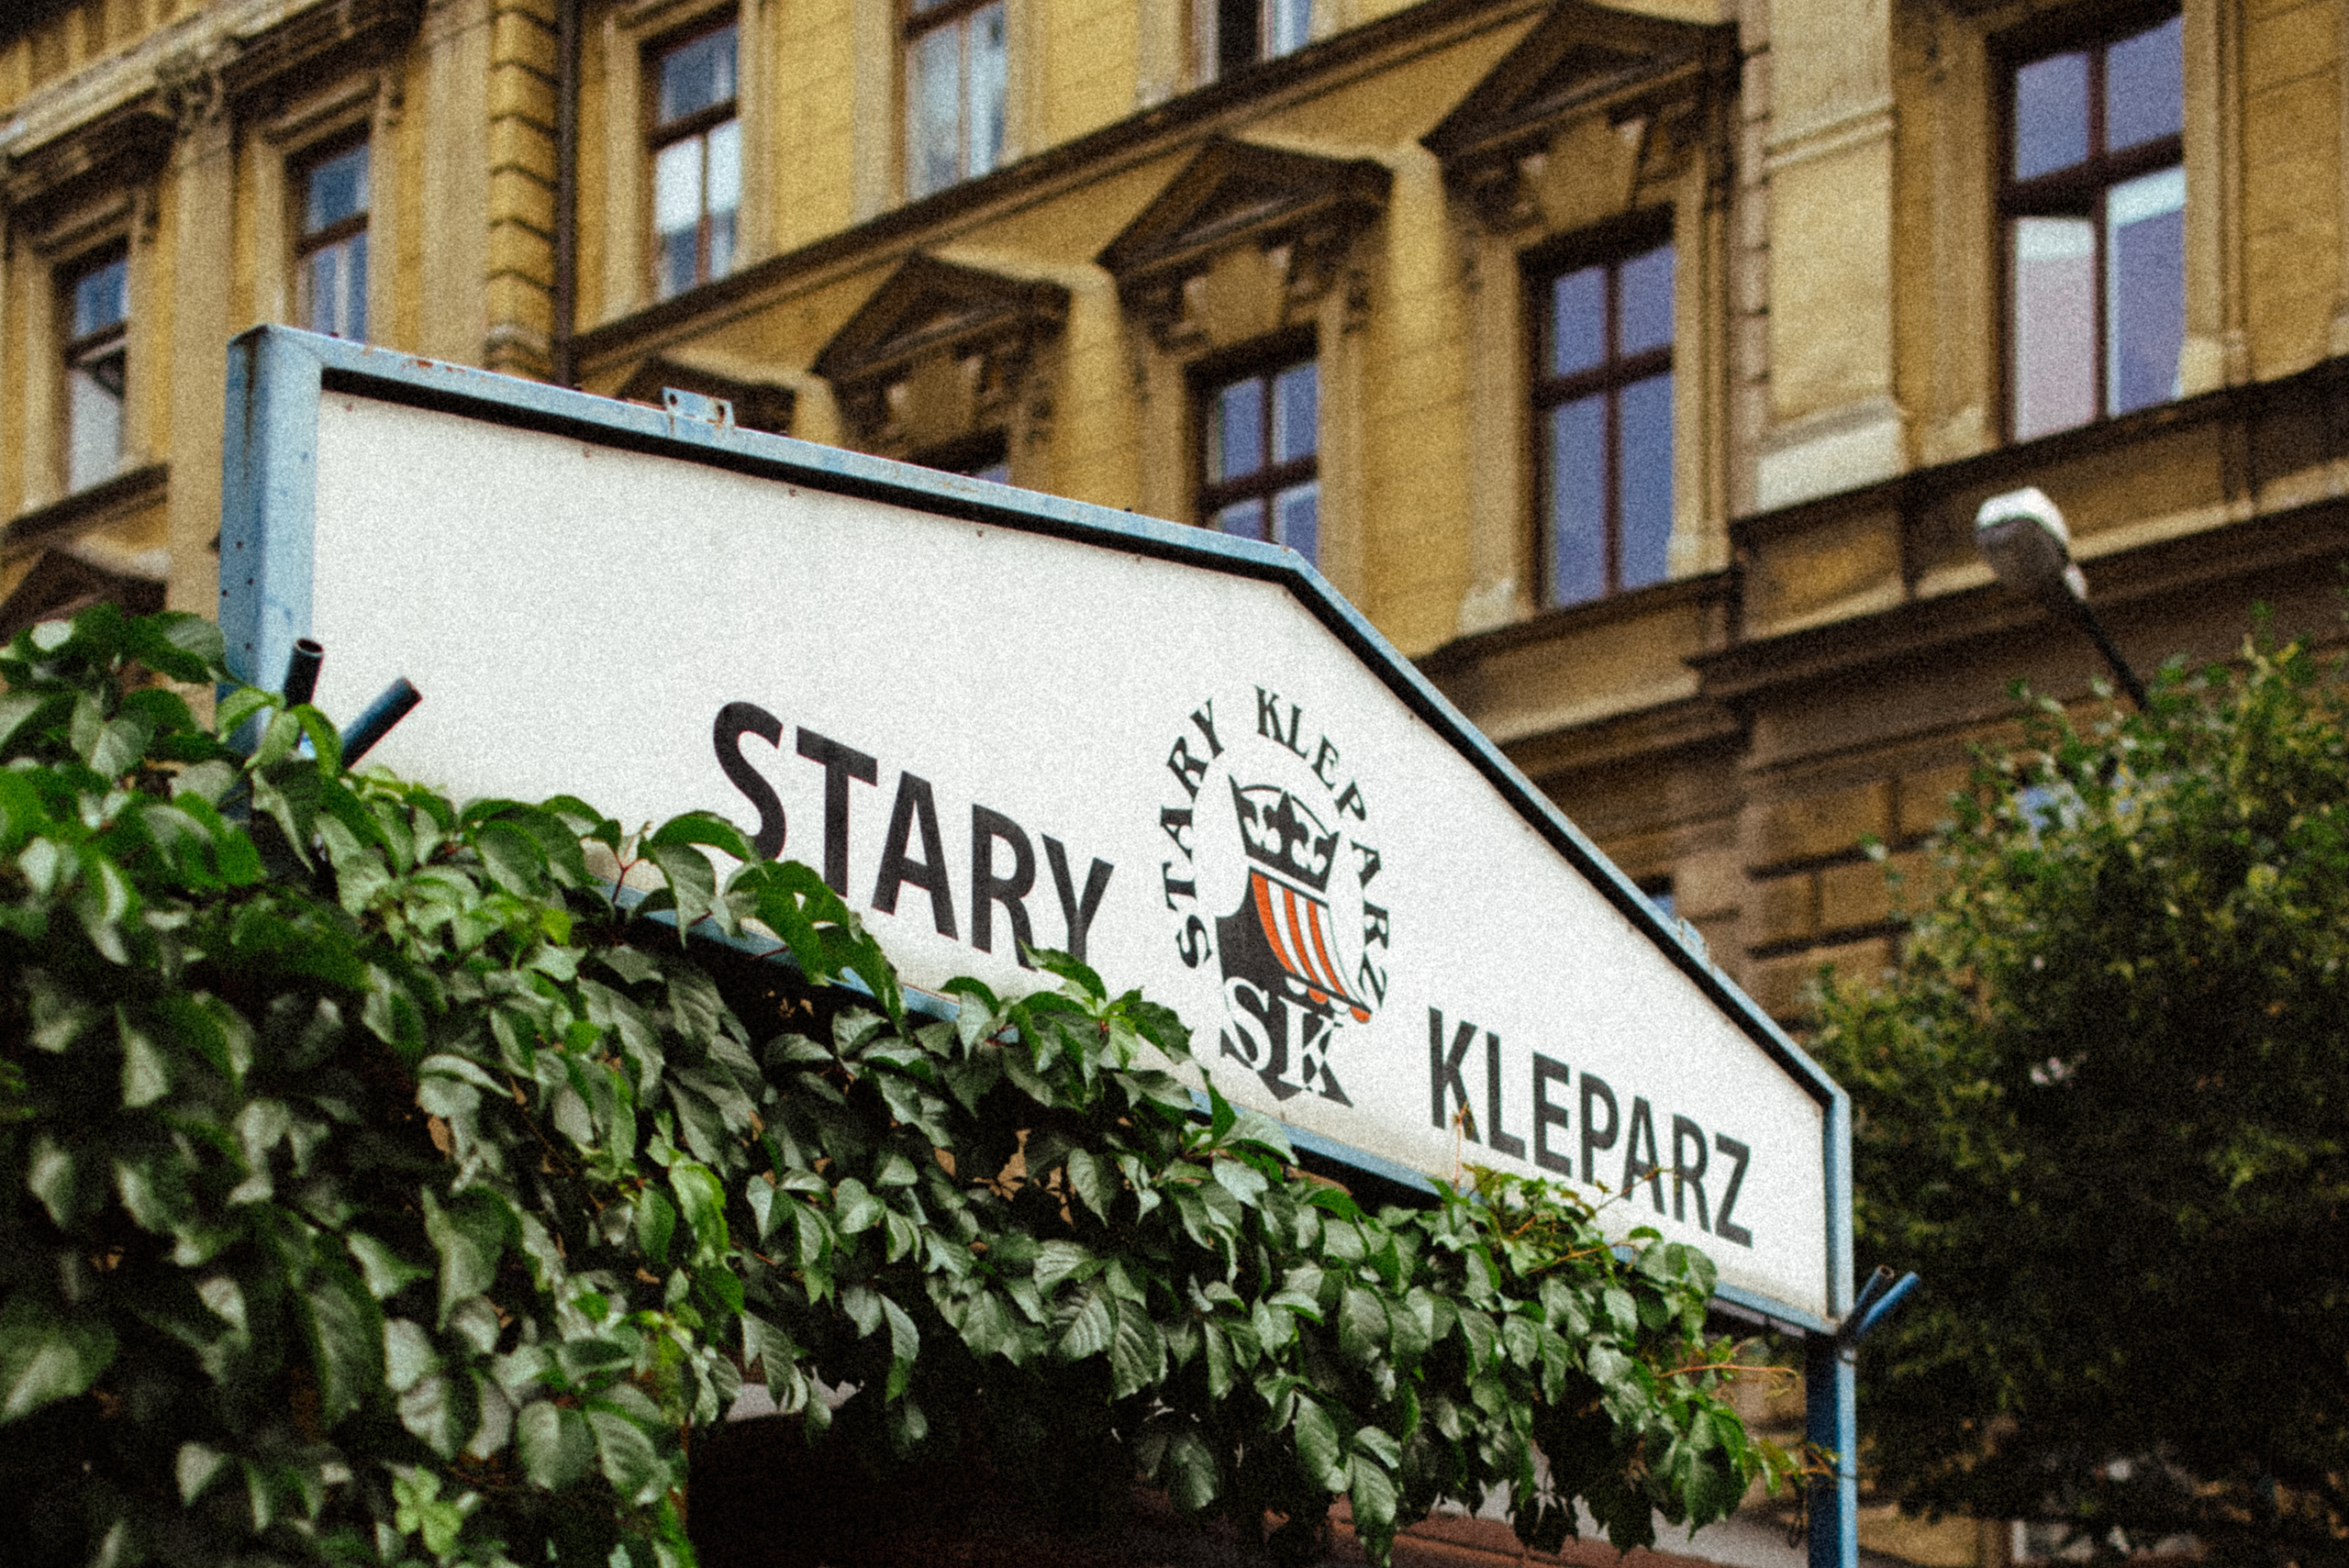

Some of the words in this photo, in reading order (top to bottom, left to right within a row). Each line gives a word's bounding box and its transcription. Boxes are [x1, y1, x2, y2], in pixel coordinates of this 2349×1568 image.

[713, 701, 1115, 972] STARY
[1428, 1006, 1753, 1250] KLEPARZ
[1160, 697, 1225, 969] STARY
[1254, 684, 1390, 1009] KLEPARZ
[1221, 976, 1347, 1100] SK
